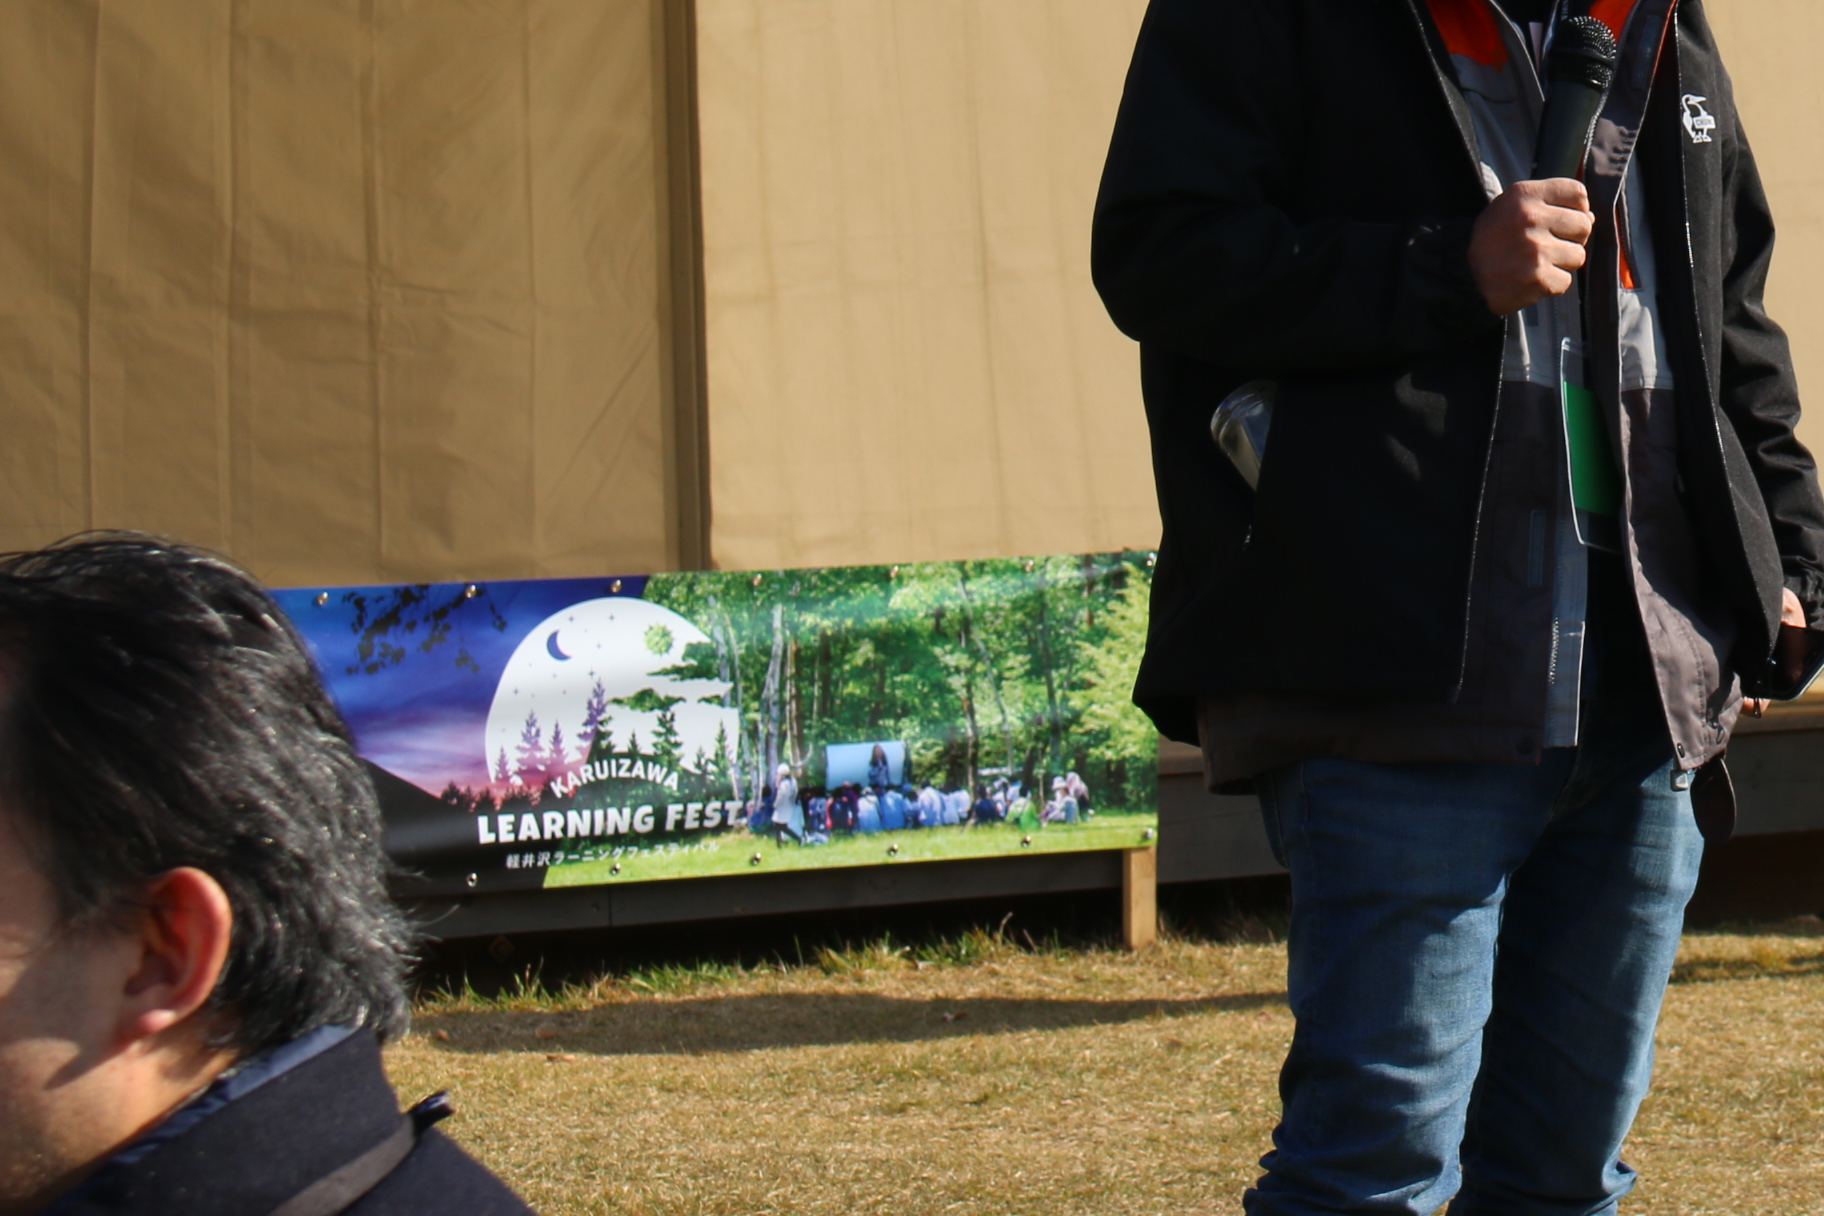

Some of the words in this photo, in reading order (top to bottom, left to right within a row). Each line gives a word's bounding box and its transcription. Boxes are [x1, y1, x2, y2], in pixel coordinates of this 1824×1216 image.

[550, 758, 679, 798] KARUIZAWA
[477, 805, 655, 844] LEARNING
[665, 800, 743, 831] FEST
[506, 841, 720, 869] 軽井沢ラーニングフェスティバル
